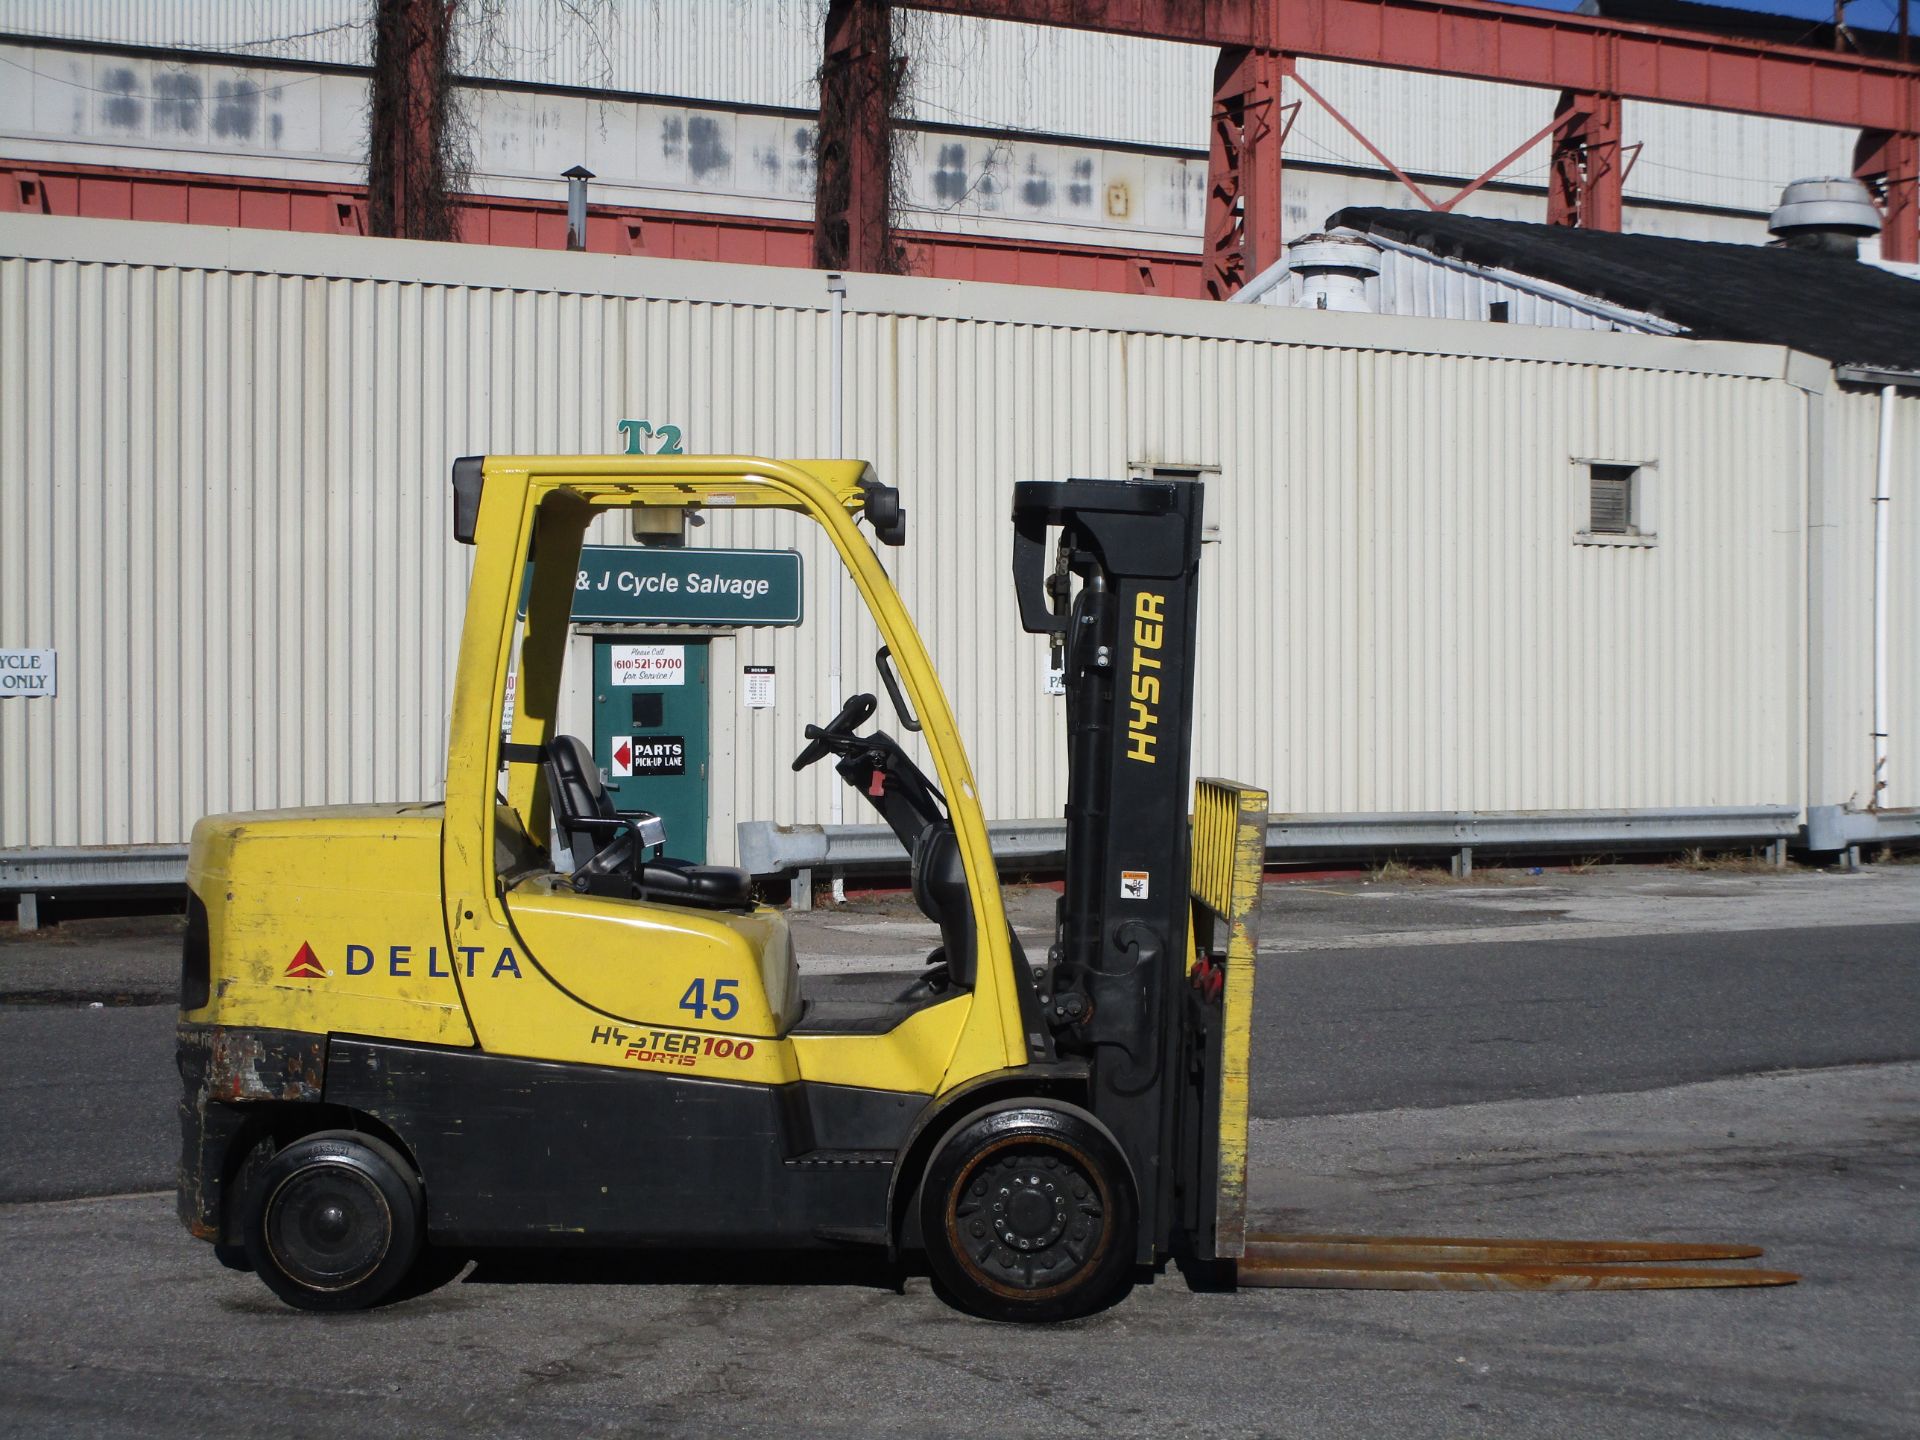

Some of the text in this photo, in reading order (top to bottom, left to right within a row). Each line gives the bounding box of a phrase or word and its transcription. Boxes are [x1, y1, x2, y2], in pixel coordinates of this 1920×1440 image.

[616, 418, 684, 455] T2
[575, 570, 770, 600] & J Cycle Salvage
[631, 647, 665, 656] Please Call
[614, 658, 682, 670] (610) 521-6700
[2, 674, 49, 689] ONLY
[623, 671, 637, 683] for
[1127, 591, 1165, 764] HYSTER
[634, 744, 682, 756] PARTS
[635, 756, 683, 767] PICK-UP LANE
[345, 944, 523, 979] DELTA
[678, 977, 740, 1021] 45
[624, 1048, 697, 1067] FORTIS
[703, 1037, 755, 1061] 100
